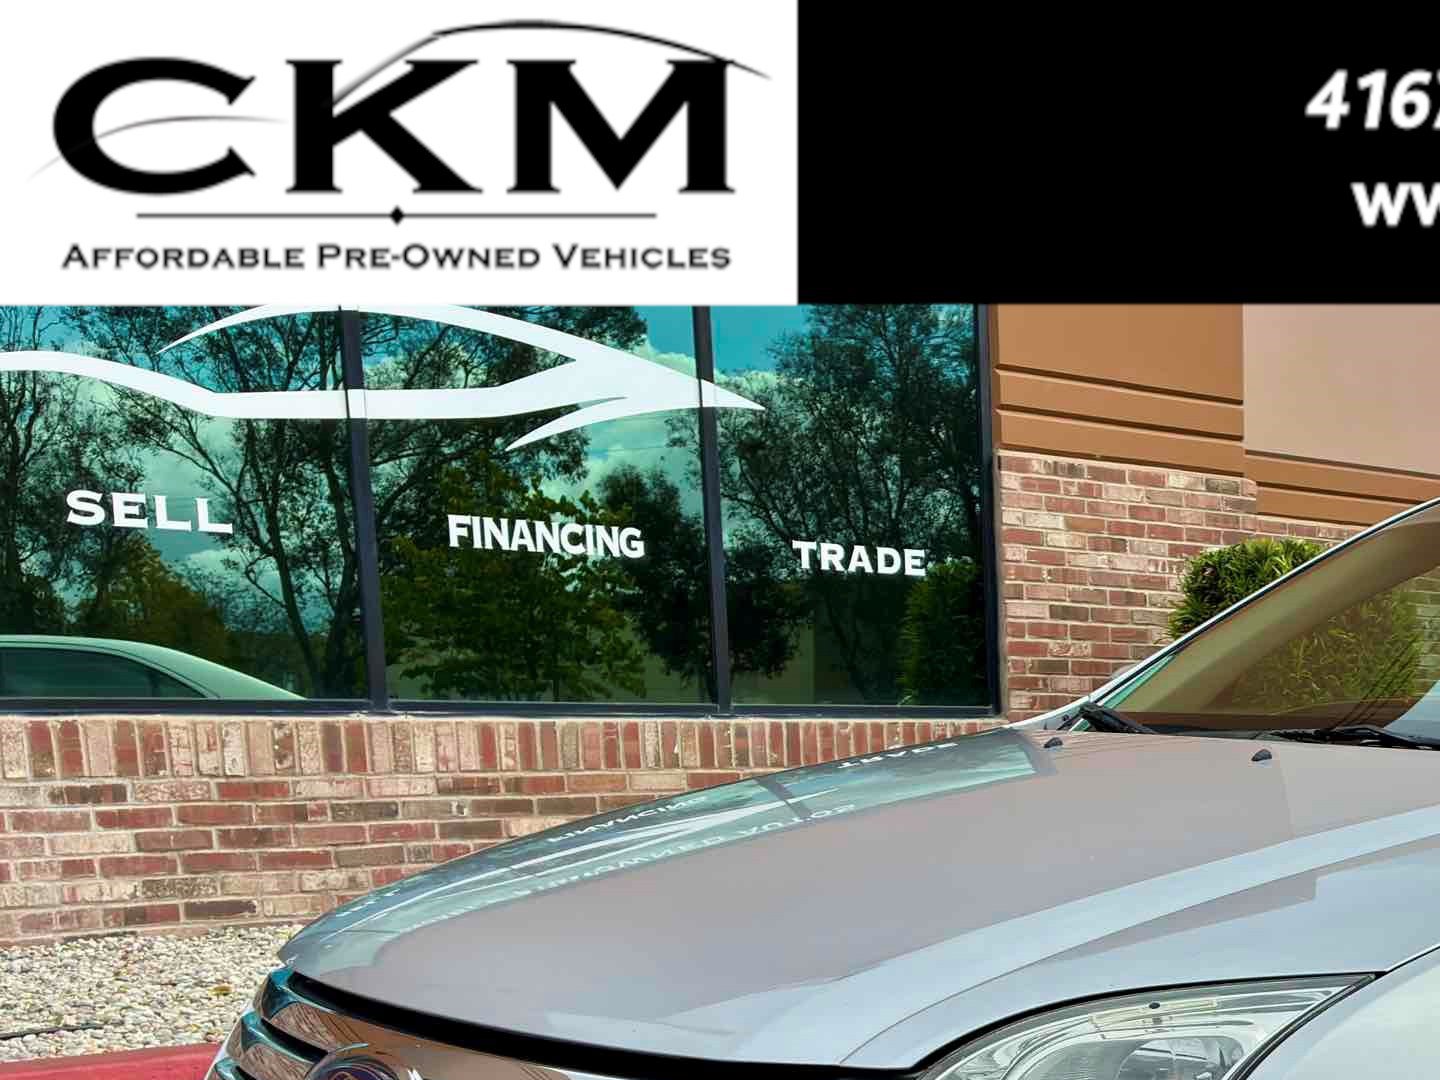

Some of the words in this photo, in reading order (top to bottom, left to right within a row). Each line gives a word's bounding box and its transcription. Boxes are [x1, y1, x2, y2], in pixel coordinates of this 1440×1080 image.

[65, 488, 235, 535] SELL
[447, 514, 646, 559] FINANCING
[790, 539, 928, 578] TRADE
